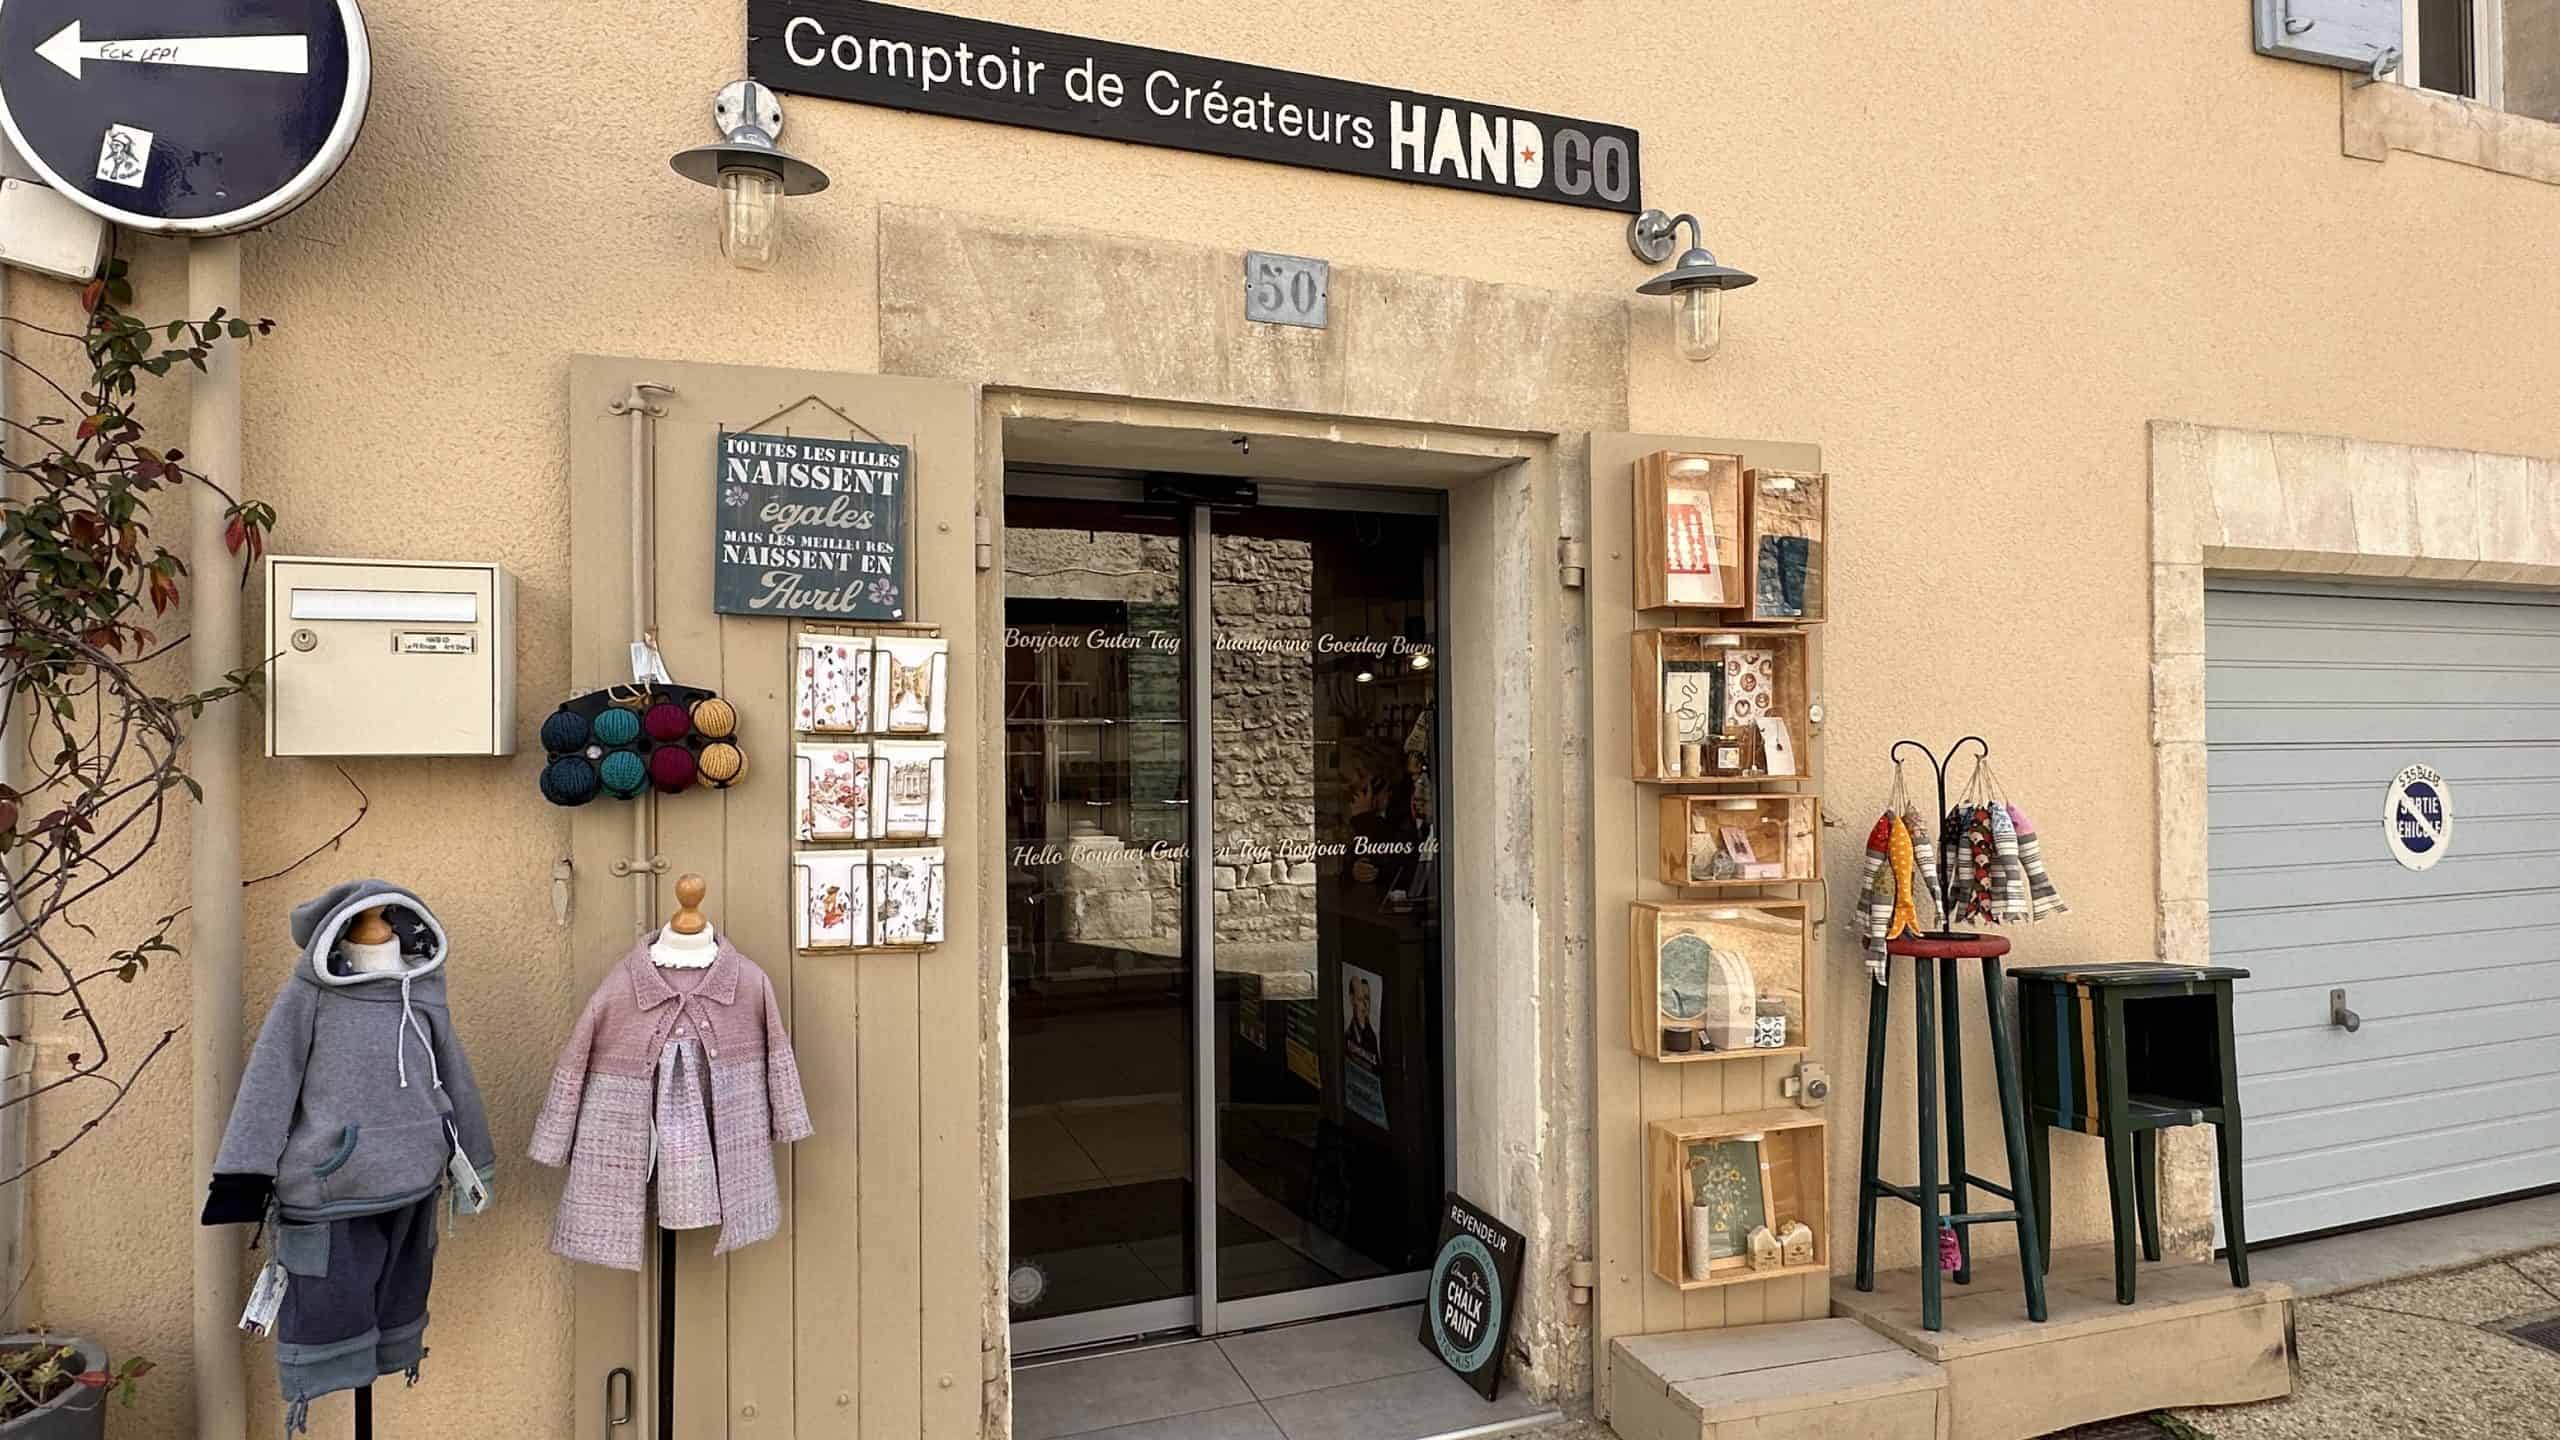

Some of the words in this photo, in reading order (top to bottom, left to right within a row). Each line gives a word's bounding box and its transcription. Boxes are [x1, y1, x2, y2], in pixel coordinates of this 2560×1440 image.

[100, 42, 134, 59] FCK
[784, 16, 1045, 95] Comptoir
[1065, 57, 1124, 108] de
[1145, 69, 1375, 150] Créateurs
[1256, 262, 1319, 313] 50
[726, 439, 797, 459] TOUTES
[803, 446, 836, 463] LES
[840, 450, 900, 468] FILLES
[726, 457, 899, 496] NAISSENT
[759, 494, 875, 534] égales
[724, 530, 763, 544] MAIS
[769, 533, 796, 546] LES
[723, 544, 852, 572] NAISSENT
[861, 554, 894, 575] EN
[749, 570, 865, 613] Avril
[1005, 627, 1080, 654] Bonjour
[1086, 629, 1143, 649] Guten
[1148, 630, 1181, 655] Tag
[1013, 845, 1064, 867] Hello
[1071, 843, 1145, 867] Bonjour
[1279, 839, 1348, 861] Bonjour
[1353, 835, 1413, 855] Buenos
[1450, 1204, 1508, 1253] REVENDEUR
[1447, 1280, 1484, 1323] CHALK
[1444, 1304, 1478, 1343] PAINT
